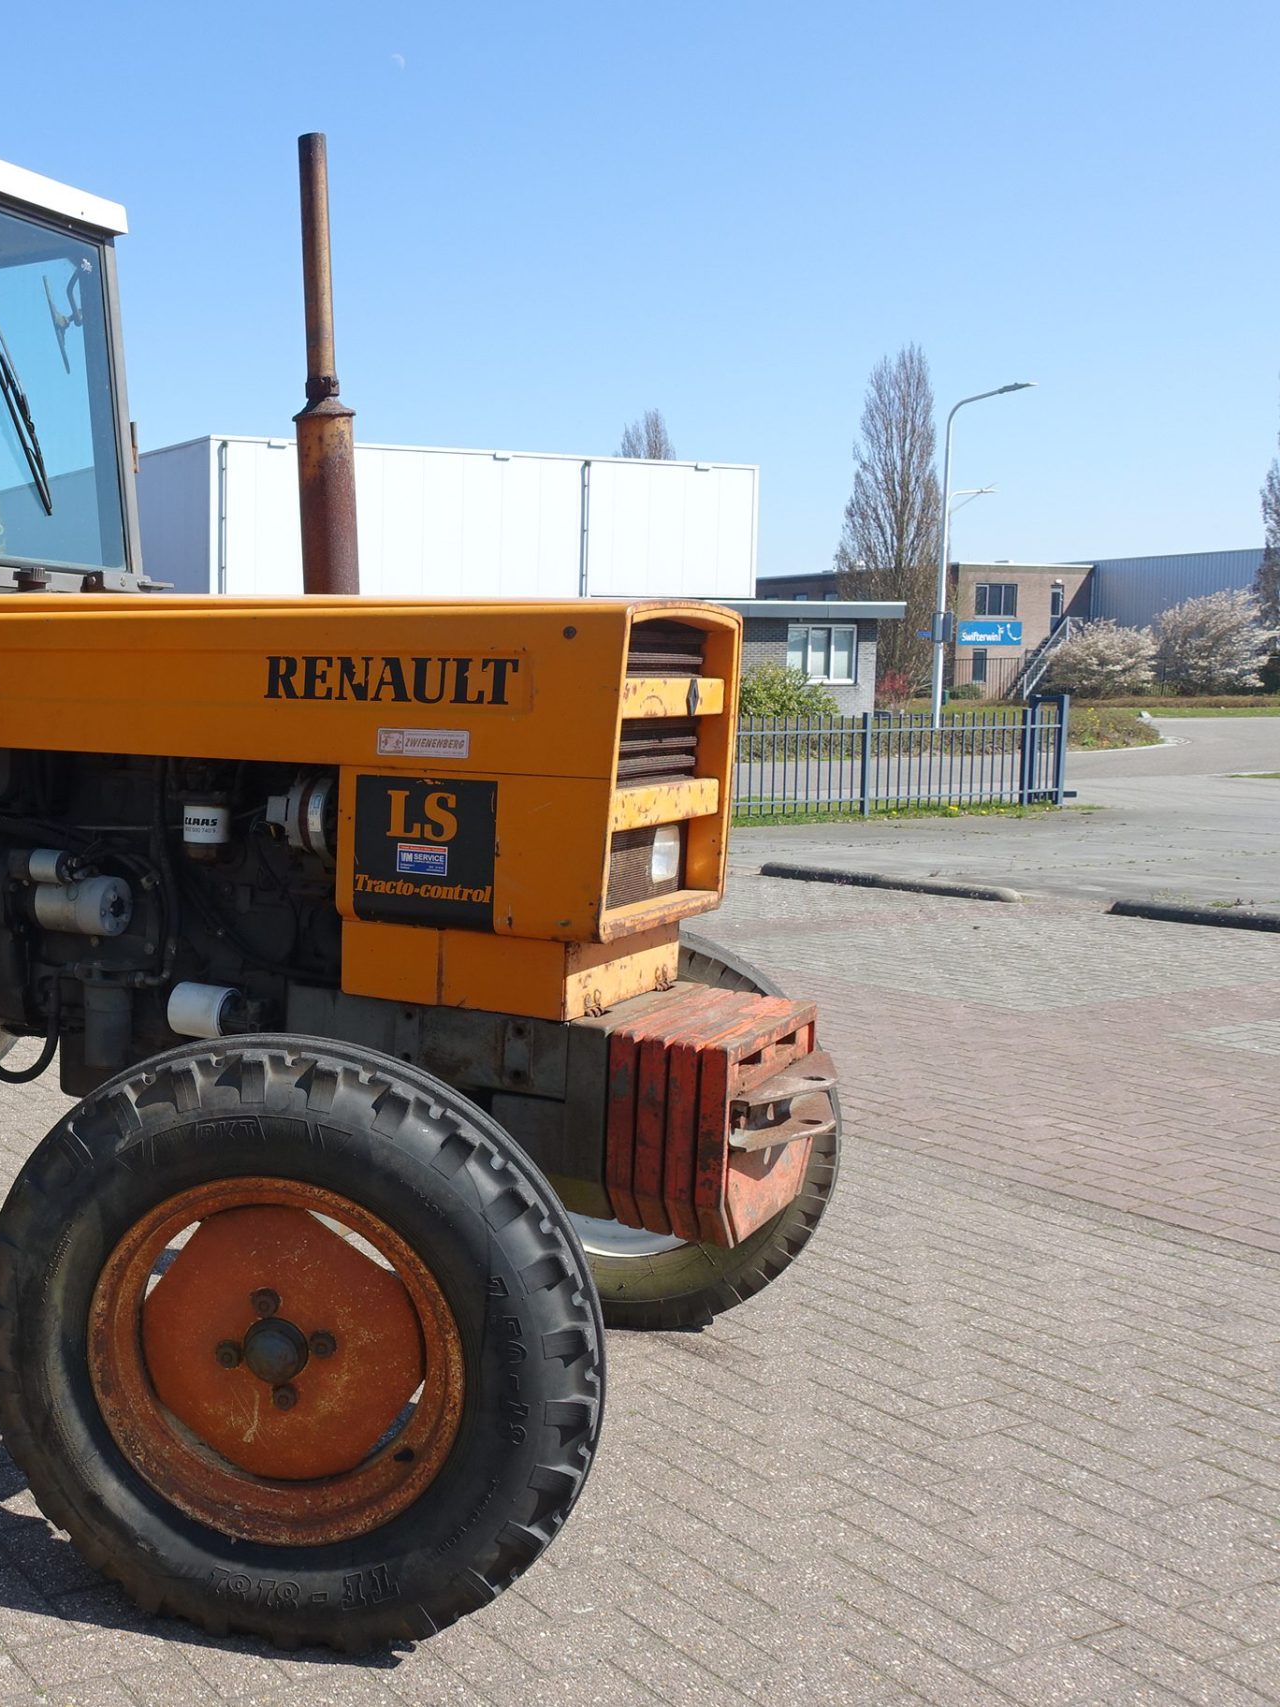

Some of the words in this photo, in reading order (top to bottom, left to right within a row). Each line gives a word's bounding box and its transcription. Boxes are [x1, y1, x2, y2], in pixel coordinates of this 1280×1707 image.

[263, 655, 520, 706] RENAULT
[404, 738, 465, 750] ZWIENENBERG
[184, 816, 218, 827] CLAAS
[386, 789, 458, 842] LS
[413, 853, 445, 863] SERVICE
[354, 873, 493, 904] Tracto-control
